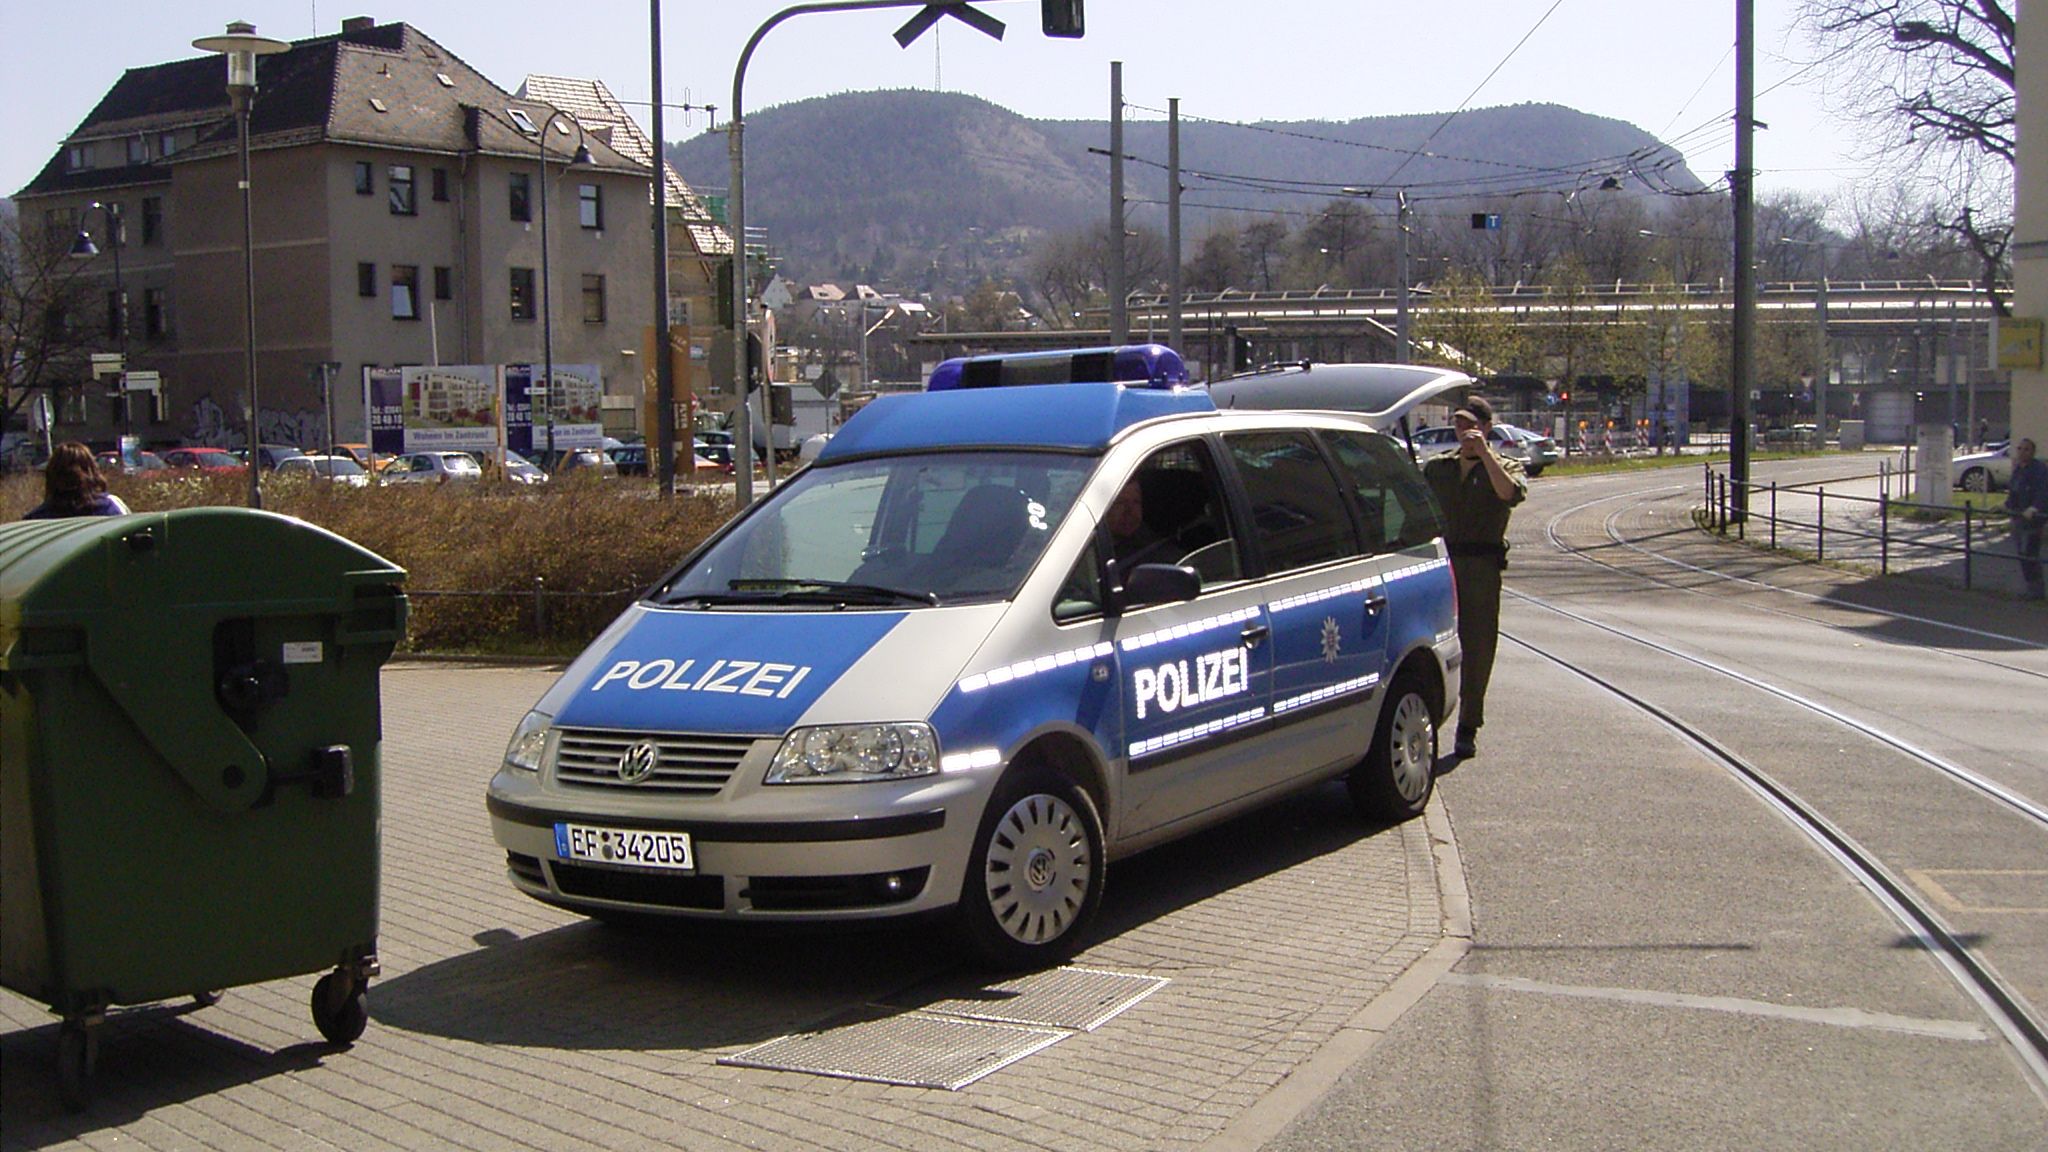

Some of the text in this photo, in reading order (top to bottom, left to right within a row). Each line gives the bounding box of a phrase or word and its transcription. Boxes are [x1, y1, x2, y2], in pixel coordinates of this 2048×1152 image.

[592, 659, 811, 698] POLIZEI
[1134, 647, 1248, 719] POLIZEI
[572, 829, 685, 863] EF 34205
